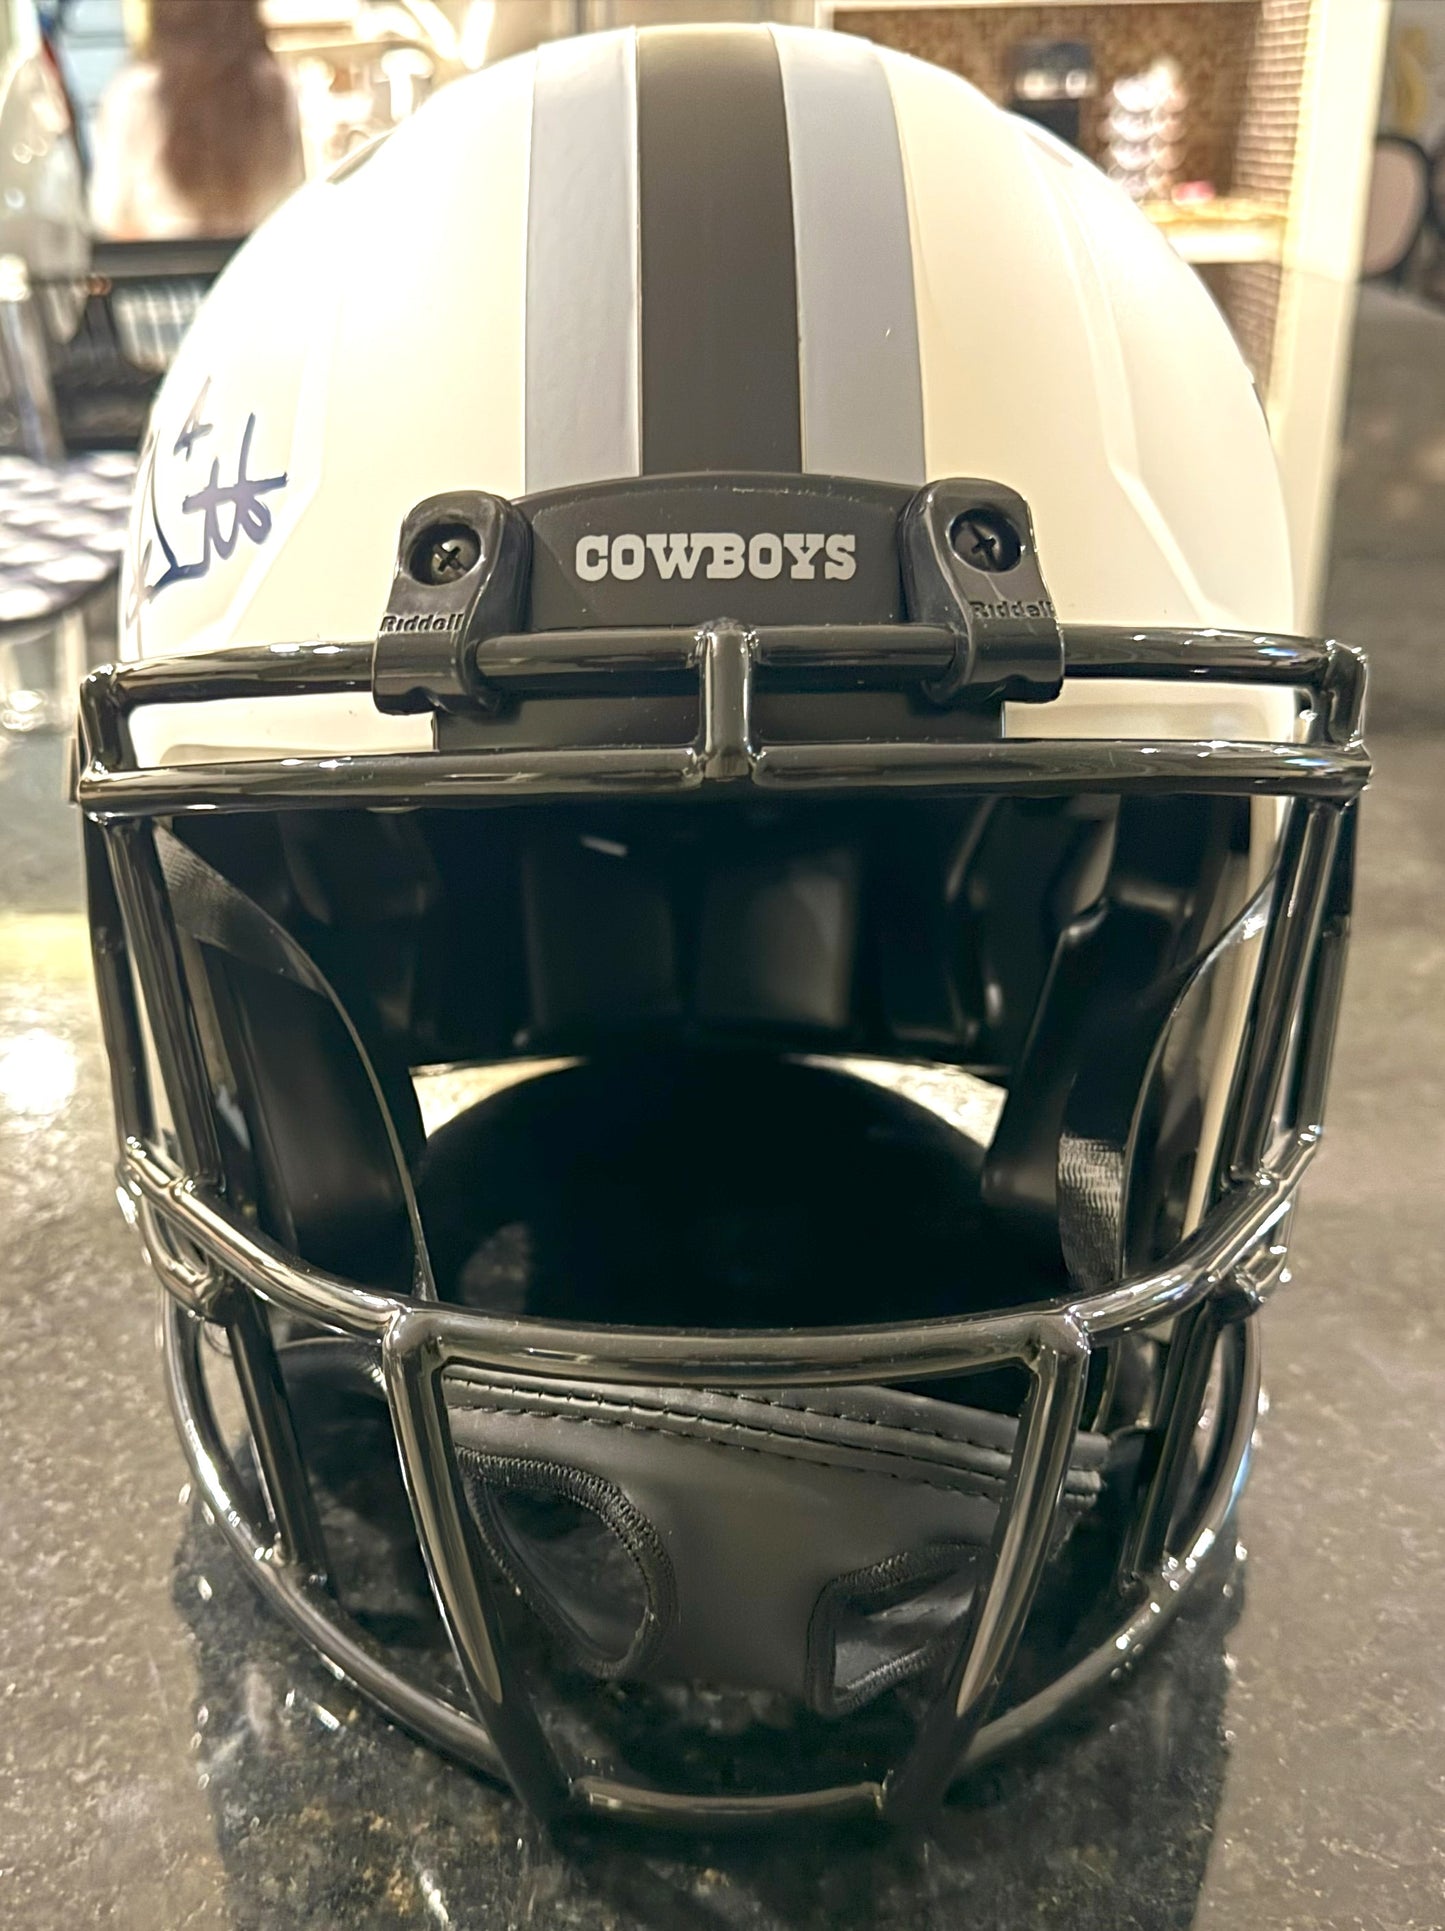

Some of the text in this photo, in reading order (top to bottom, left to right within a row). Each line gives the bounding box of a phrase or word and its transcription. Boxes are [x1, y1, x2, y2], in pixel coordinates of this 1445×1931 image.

[575, 532, 857, 582] COWBOYS
[969, 600, 1055, 618] Riddell
[379, 612, 464, 633] Riddell
